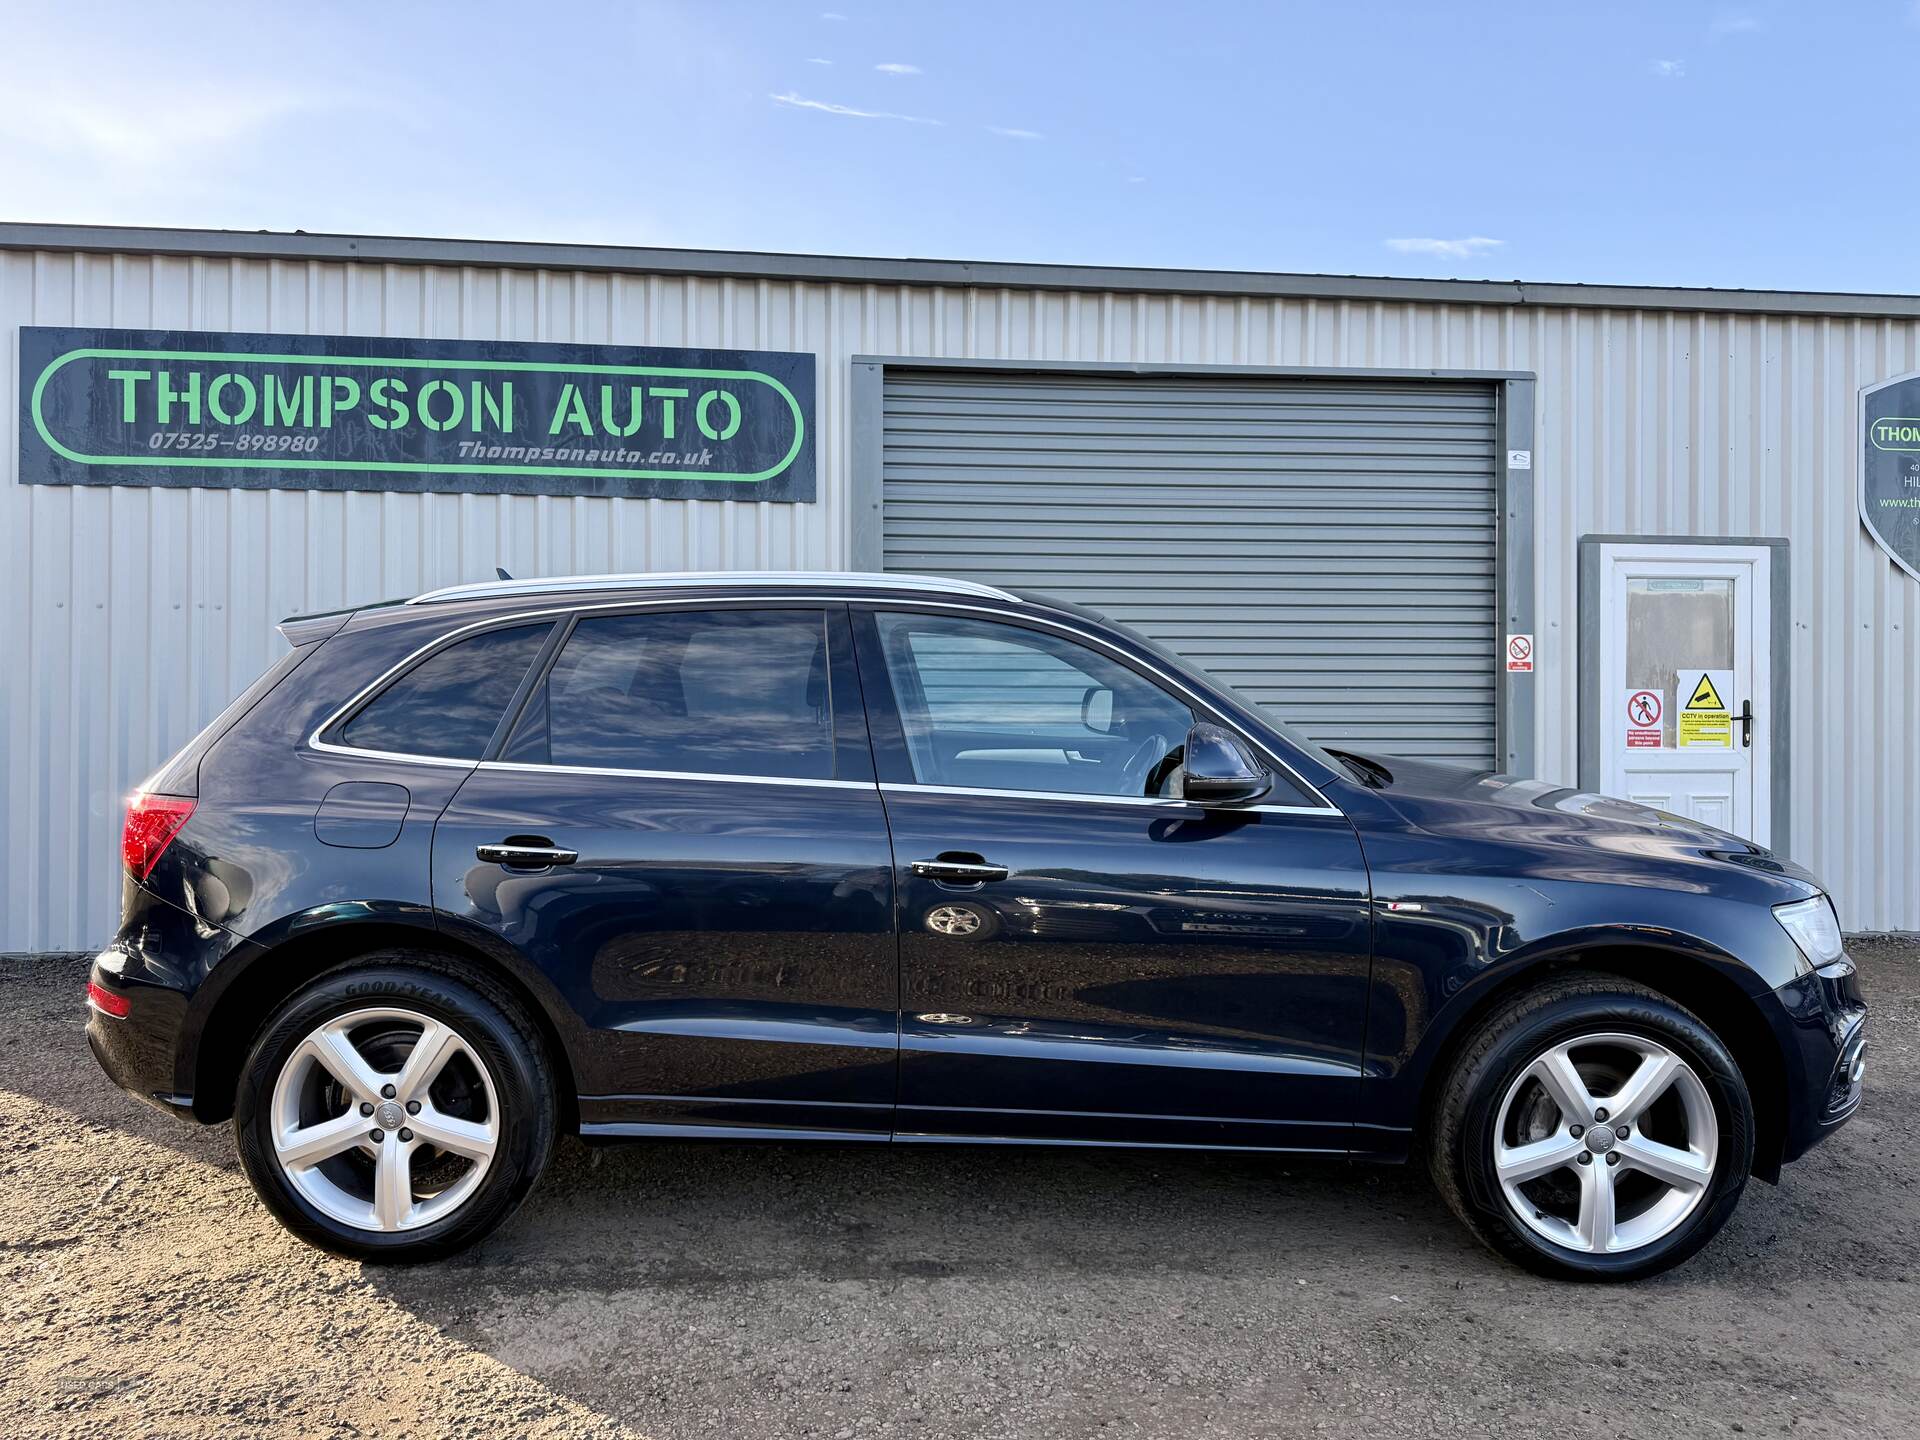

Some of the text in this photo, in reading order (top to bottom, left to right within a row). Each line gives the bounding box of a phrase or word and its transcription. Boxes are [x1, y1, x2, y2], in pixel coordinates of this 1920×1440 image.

[108, 370, 741, 440] THOMPSON AUTO
[149, 432, 319, 452] 07525-898980
[458, 441, 713, 465] Thompsonauto.co.uk
